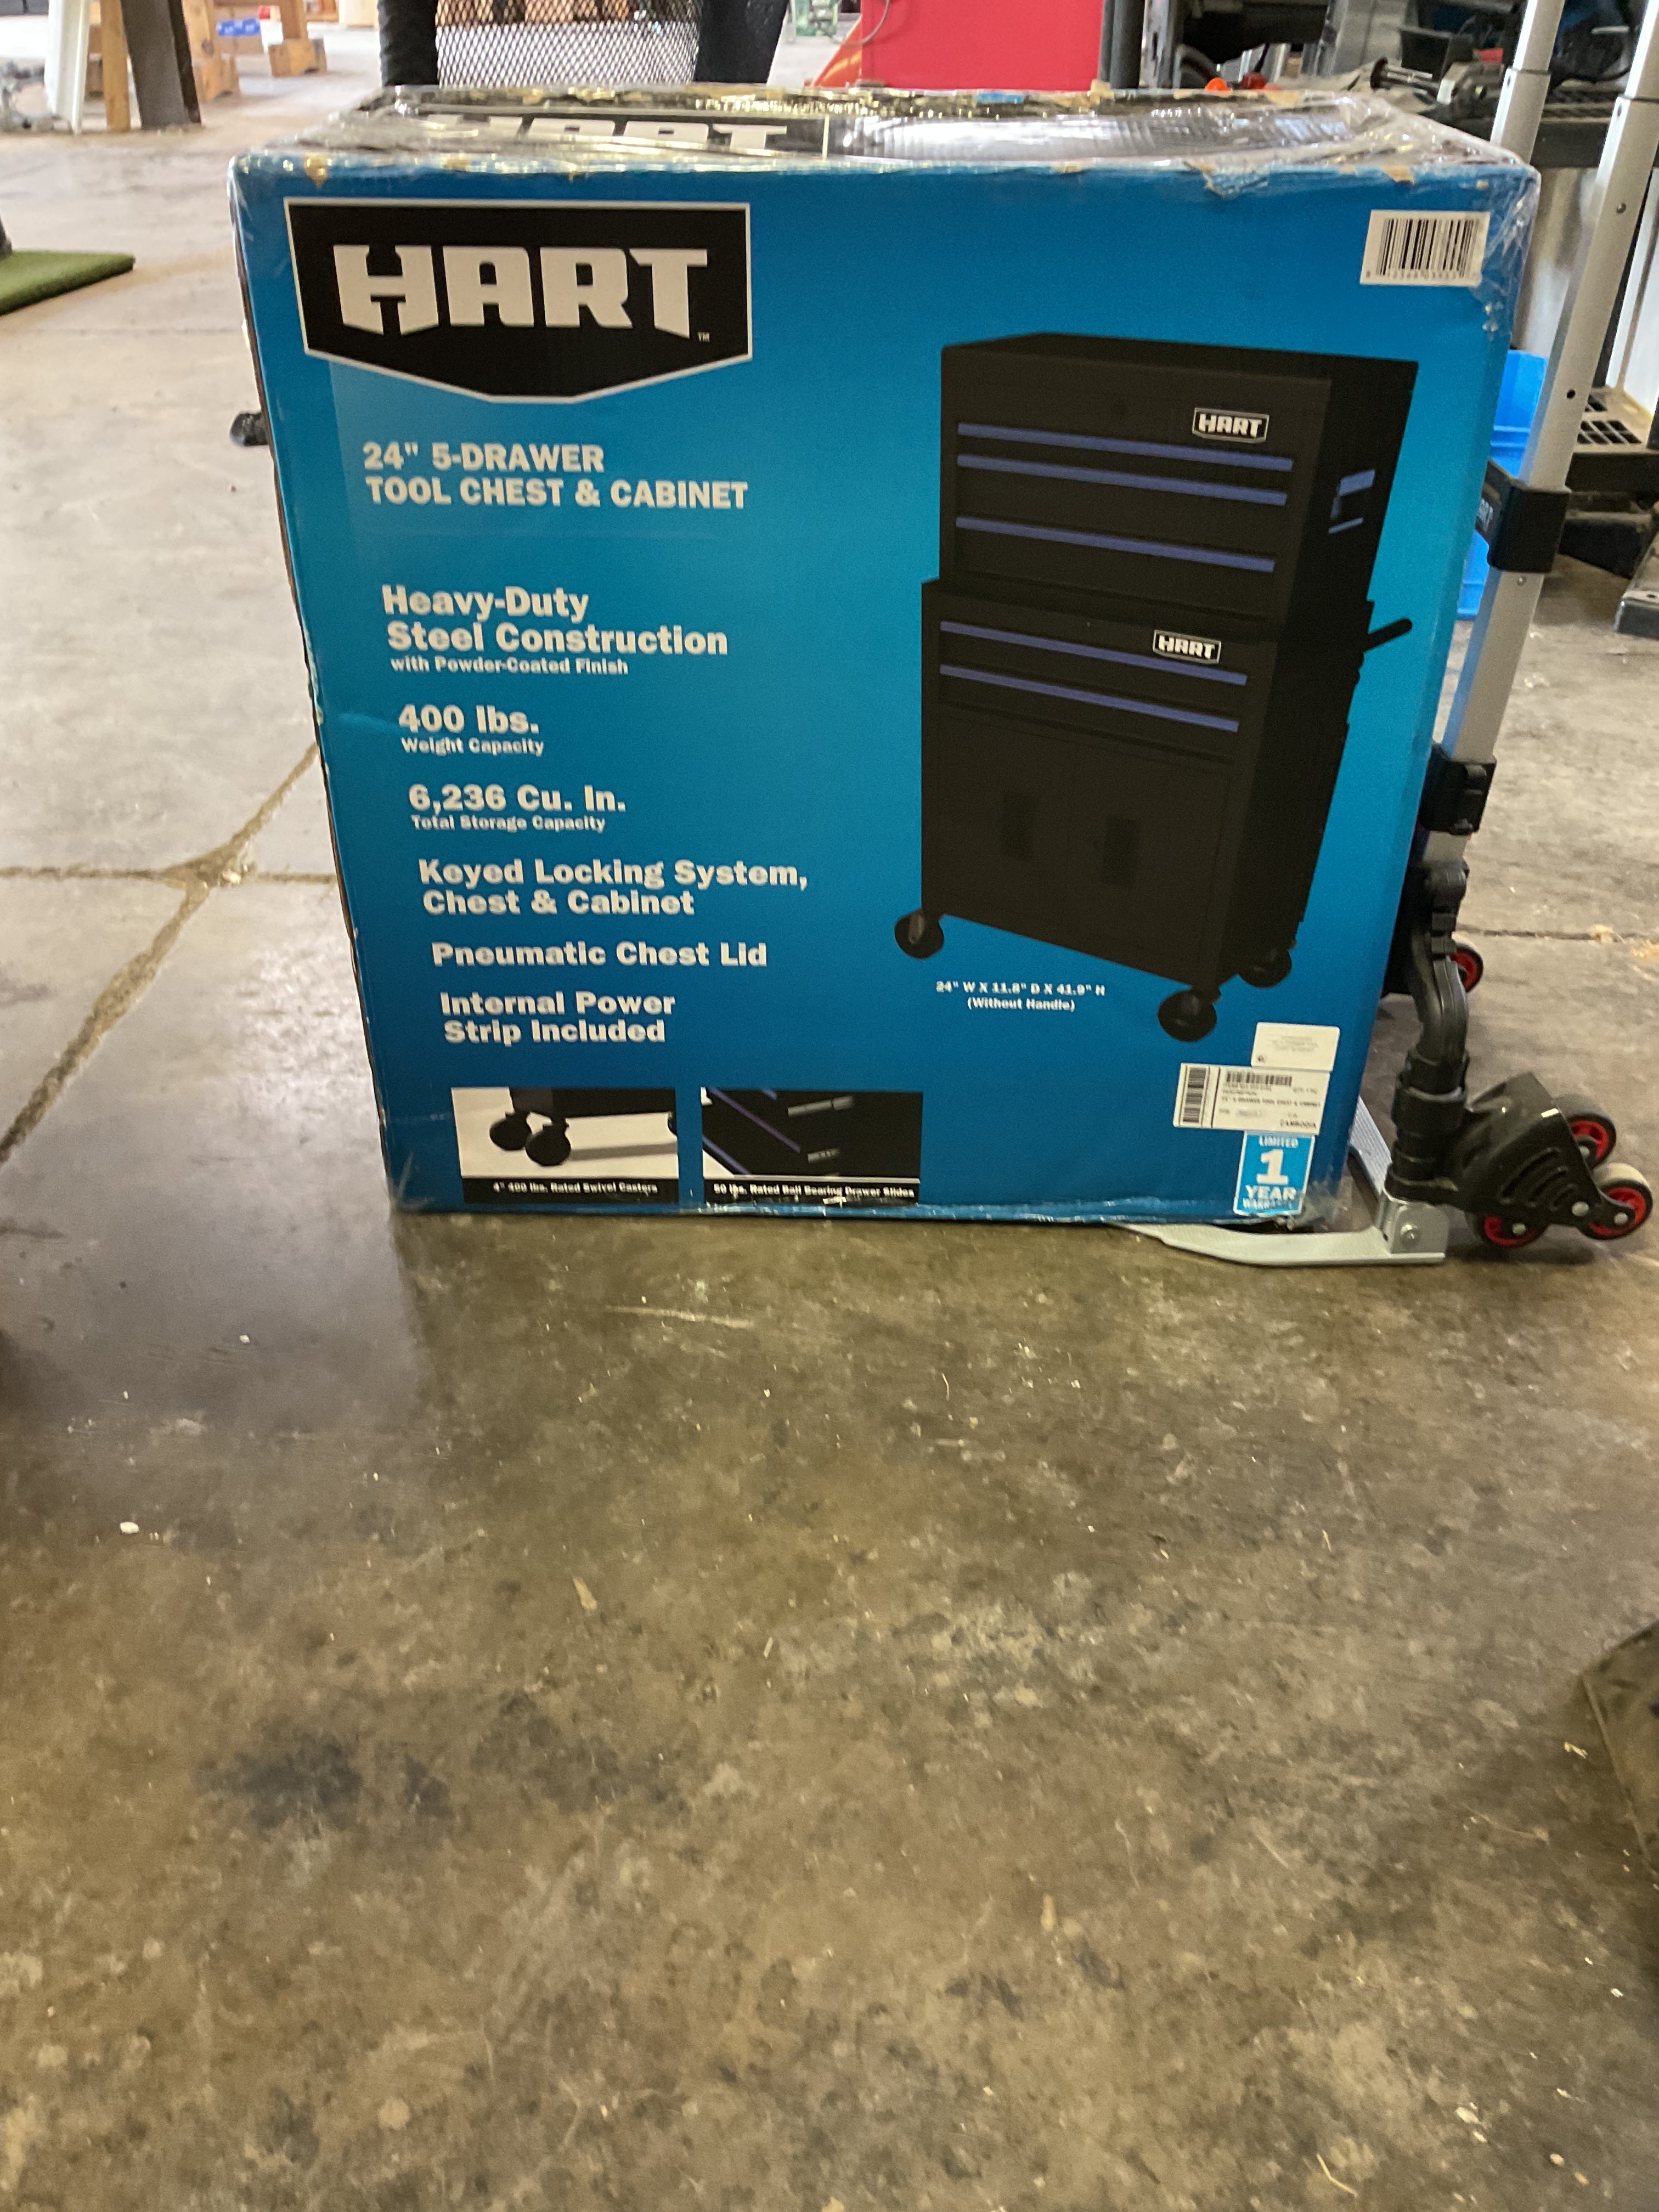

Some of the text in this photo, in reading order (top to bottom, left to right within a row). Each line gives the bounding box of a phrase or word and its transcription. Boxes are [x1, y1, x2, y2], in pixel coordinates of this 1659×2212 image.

[333, 245, 708, 339] HART
[1198, 413, 1262, 438] HART
[363, 442, 604, 472] 24" 5-DRAWER
[365, 476, 748, 509] TOOL CHEST & CABINET
[382, 584, 589, 622] Heavy-Duty
[387, 621, 727, 655] Steel Construction
[1158, 635, 1215, 660] HART
[391, 656, 628, 674] with Powder-Coated Finish
[398, 704, 539, 733] 400 lbs.
[401, 737, 544, 757] Weight Capacity
[409, 784, 626, 815] 6,236 Cu. In.
[411, 815, 605, 833] Total Storage Capacity
[419, 859, 808, 891] Keyed Locking System,
[423, 889, 695, 915] Chest & Cabinet
[432, 941, 767, 966] Pneumatic Chest Lid
[440, 991, 675, 1015] Internal Power
[444, 1019, 665, 1046] Strip Included
[1259, 1136, 1299, 1148] LIMITED
[1256, 1148, 1289, 1186] 1
[1245, 1184, 1297, 1200] YEAR
